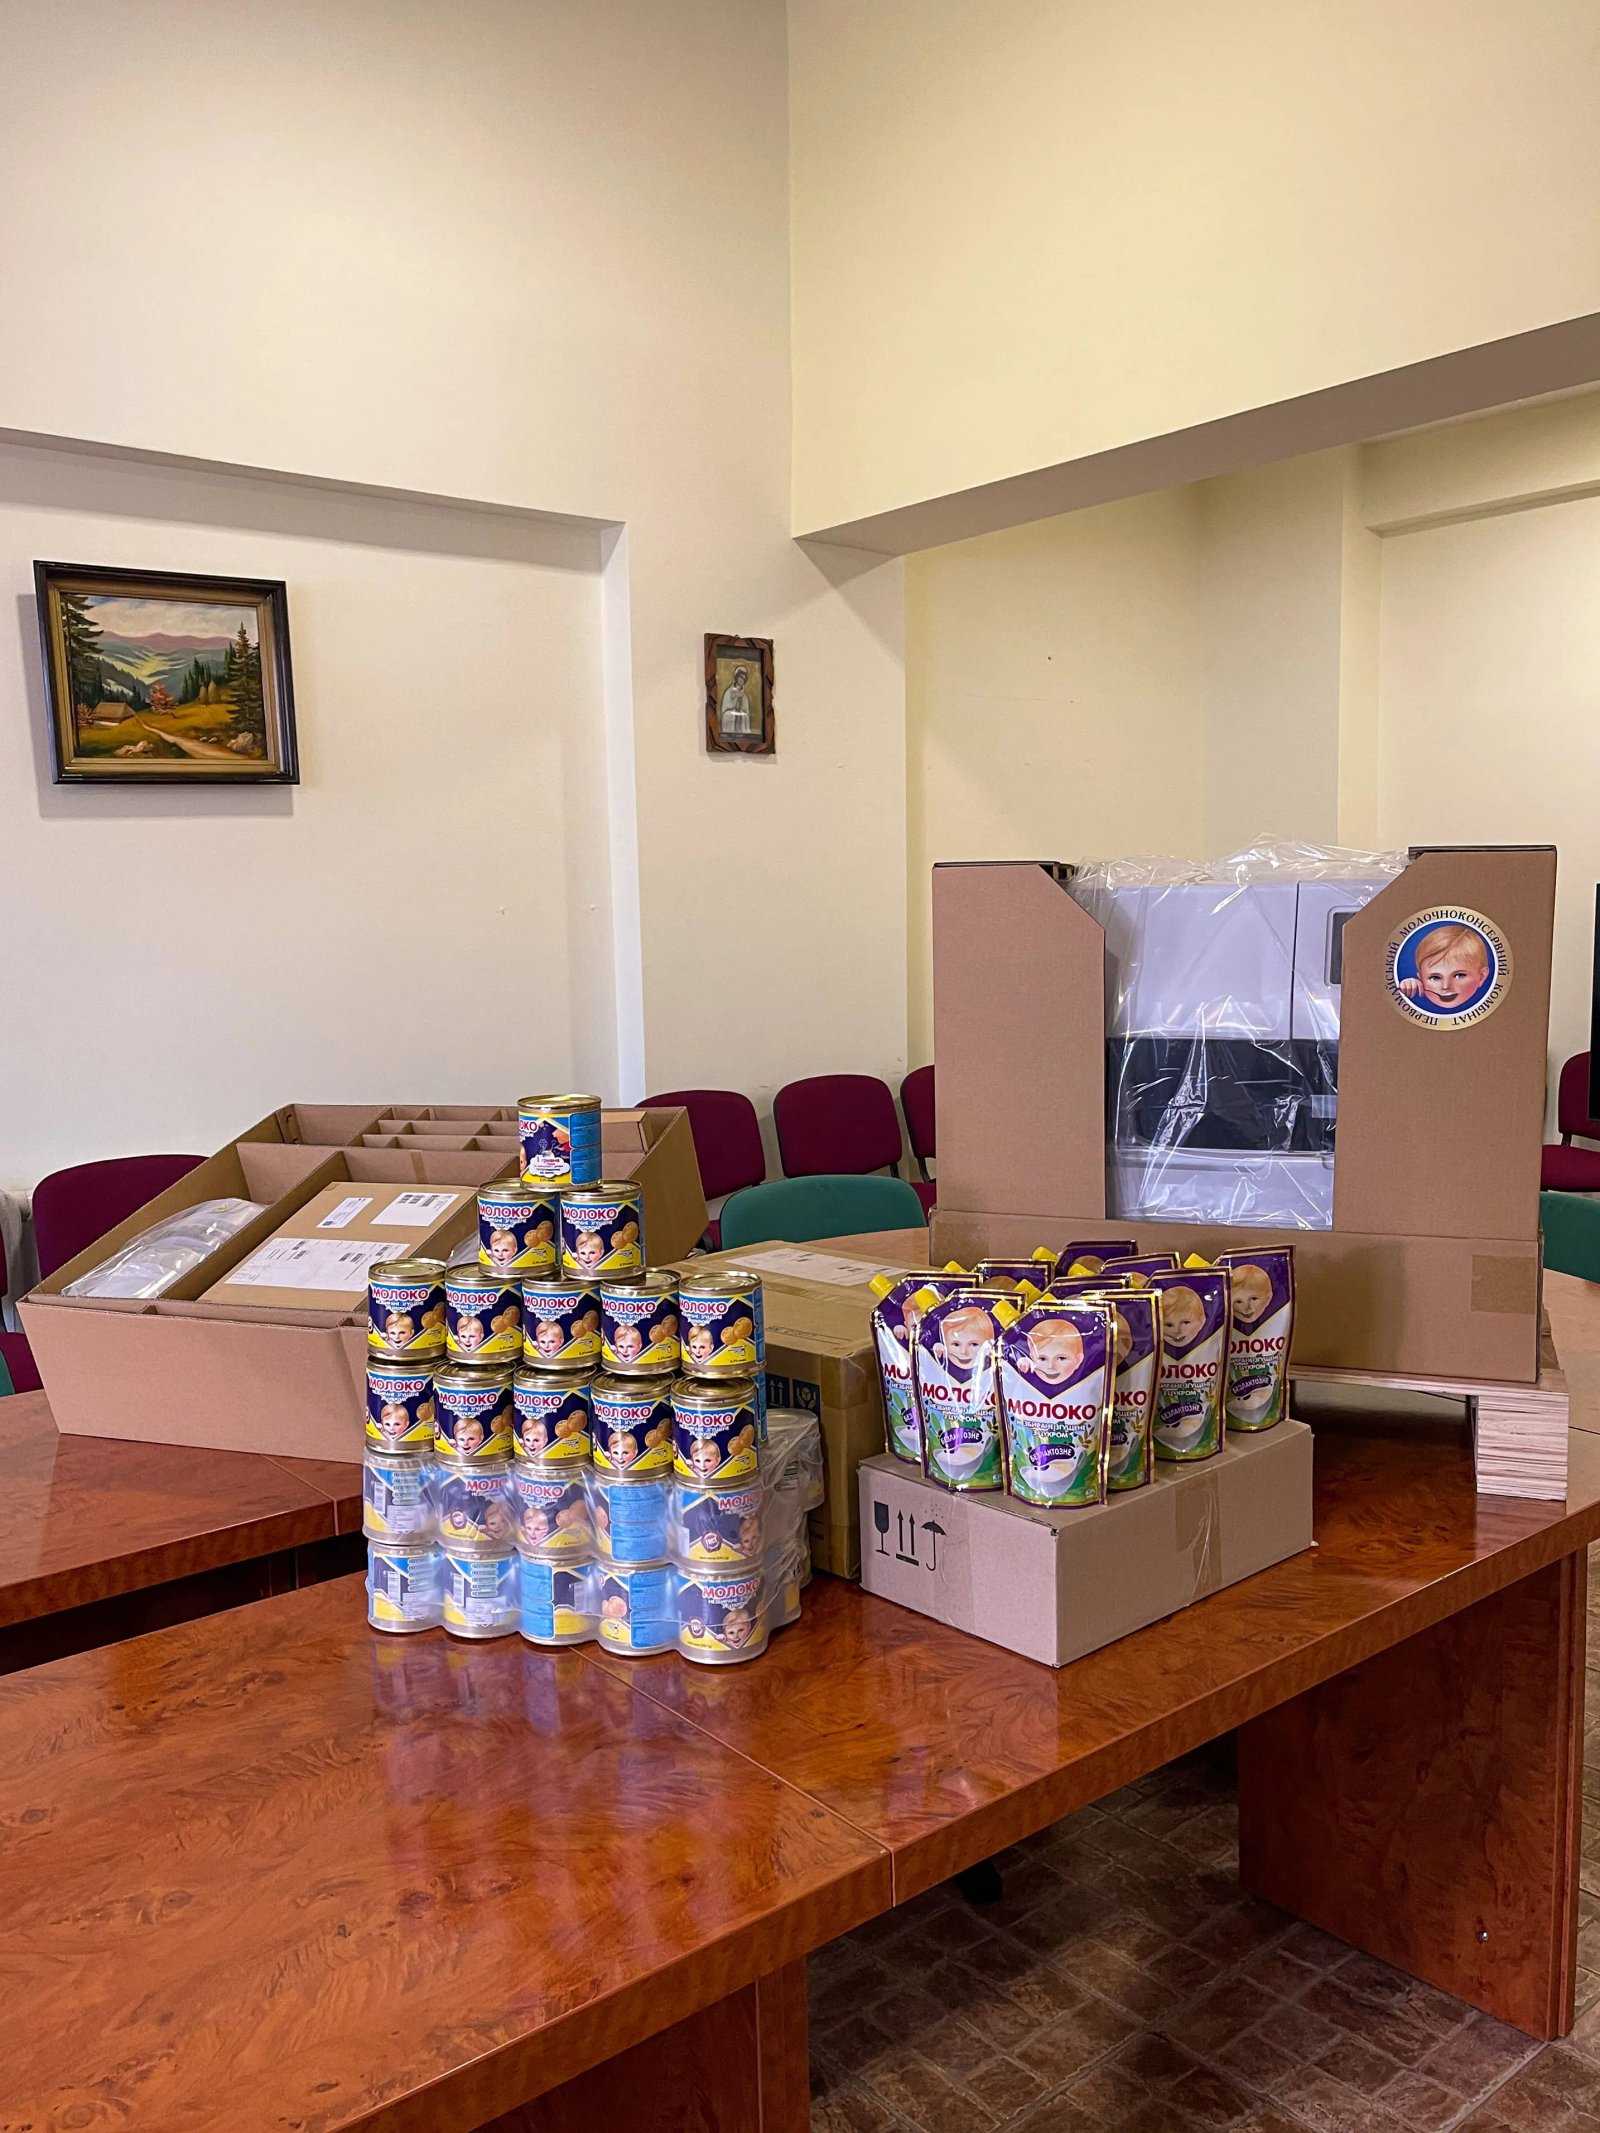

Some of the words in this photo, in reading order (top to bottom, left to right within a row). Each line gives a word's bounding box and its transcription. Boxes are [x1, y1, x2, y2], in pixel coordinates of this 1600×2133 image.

[1400, 910, 1509, 976] МОЛОЧНОКОНСЕРВНИЙ
[1385, 942, 1438, 1026] ПЕРВОМАЙСЬКИЙ
[1451, 983, 1503, 1026] КОМБІНАТ
[479, 1204, 532, 1217] МОЛОКО
[564, 1206, 617, 1219] МОЛОКО
[373, 1288, 428, 1300] МОЛОКО
[447, 1291, 497, 1304] МОЛОКО
[525, 1297, 577, 1309] МОЛОКО
[603, 1301, 655, 1313] МОЛОКО
[681, 1301, 727, 1314] МОЛОКО
[369, 1379, 424, 1391] МОЛОКО
[440, 1393, 497, 1404] МОЛОКО
[514, 1393, 562, 1406] МОЛОКО
[595, 1405, 651, 1418] МОЛОКО
[1008, 1399, 1096, 1420] МОЛОКО
[676, 1413, 734, 1426] МОЛОКО
[703, 1579, 760, 1598] МОЛОКО
